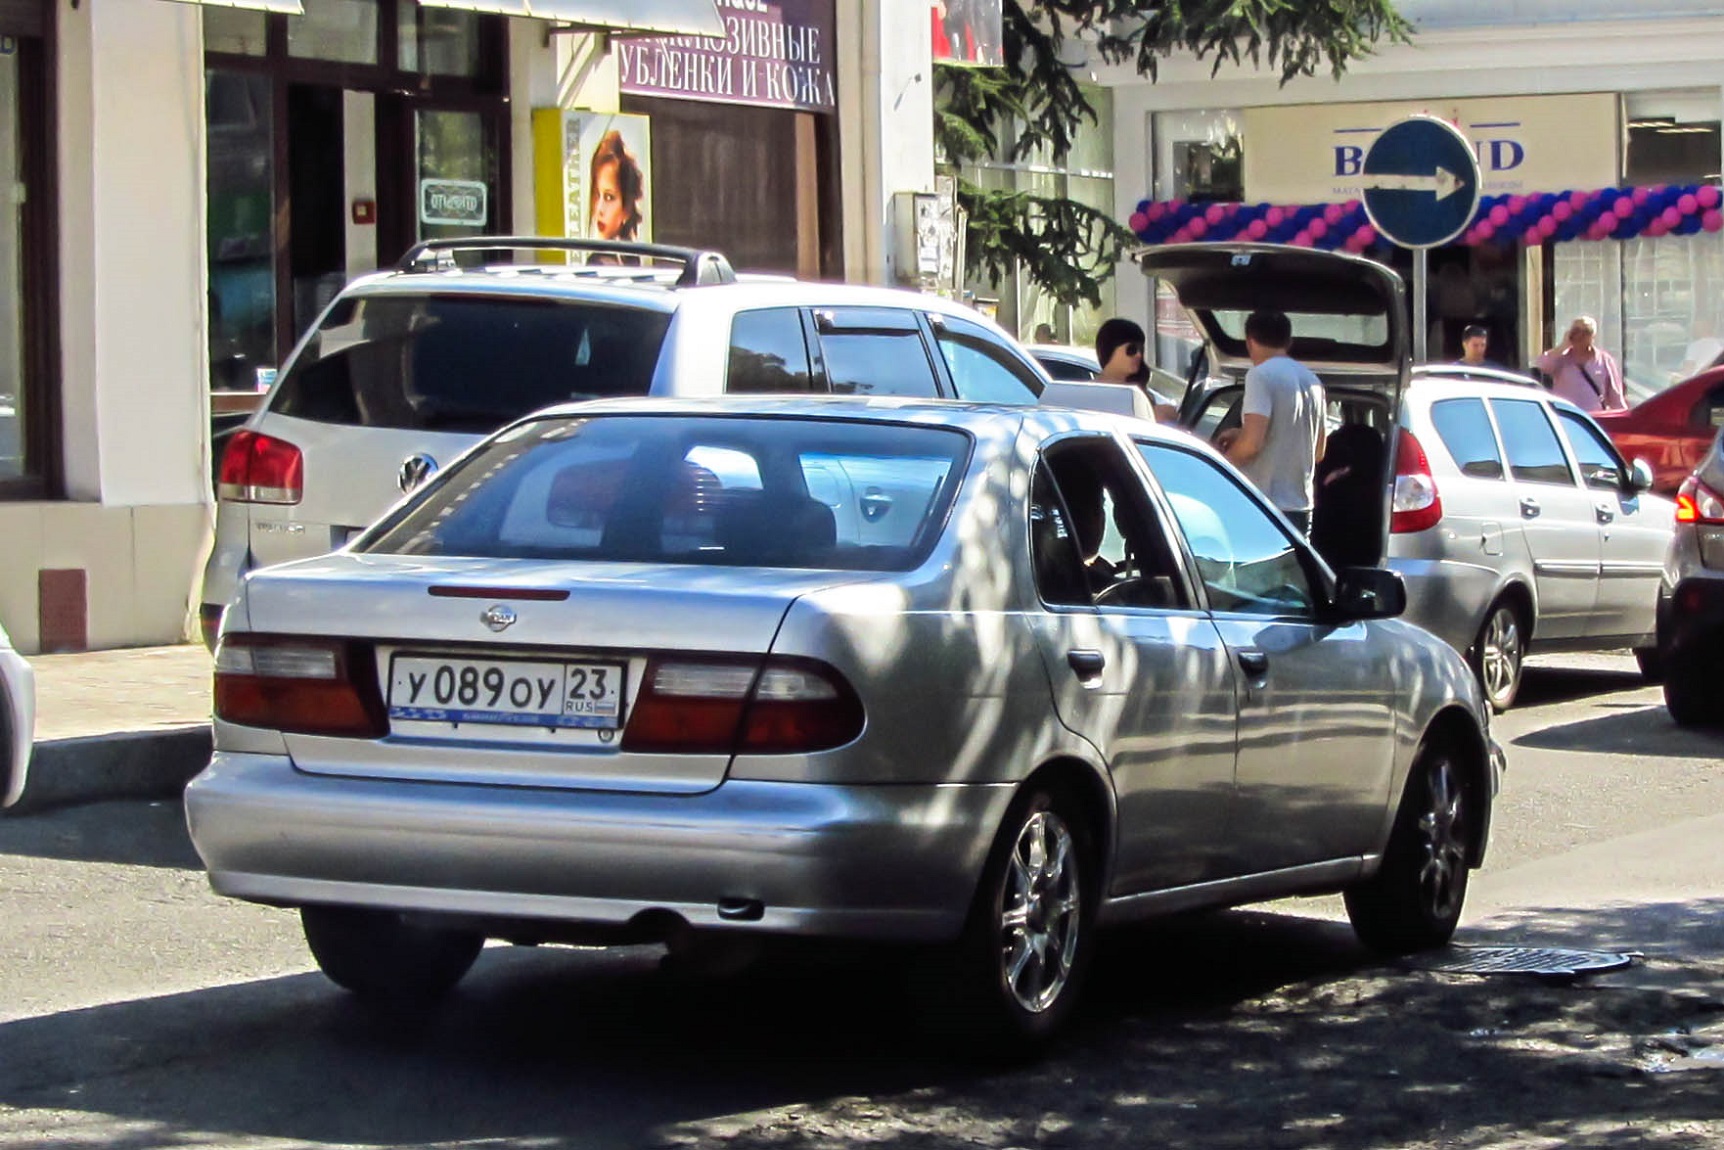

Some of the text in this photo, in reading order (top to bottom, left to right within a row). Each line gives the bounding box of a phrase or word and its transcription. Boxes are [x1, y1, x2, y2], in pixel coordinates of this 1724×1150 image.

[620, 43, 836, 107] УБЛЕНКИ И КОЖА
[569, 668, 607, 701] 23
[565, 700, 594, 713] RUS
